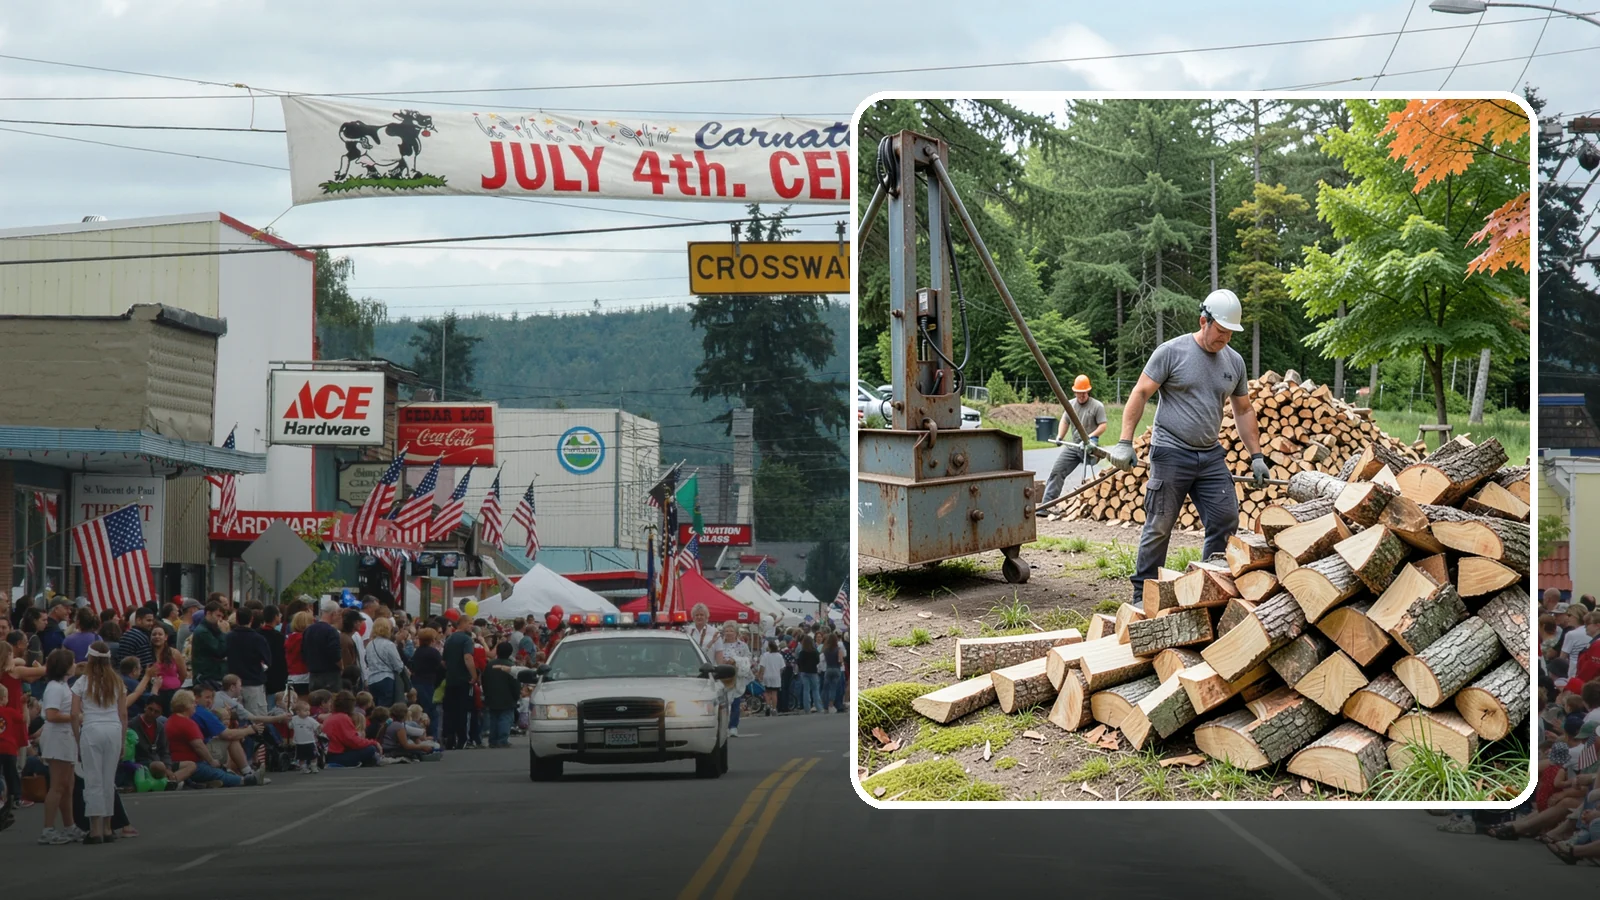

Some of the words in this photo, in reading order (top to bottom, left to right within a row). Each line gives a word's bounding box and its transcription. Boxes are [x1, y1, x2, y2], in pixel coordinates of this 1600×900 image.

[695, 121, 850, 150] Carnat
[481, 141, 604, 193] JULY
[632, 151, 746, 197] 4th.
[697, 254, 850, 280] CROSSWA
[283, 380, 373, 420] ACE
[405, 409, 452, 422] CEDAR
[283, 421, 370, 436] Hardware
[416, 428, 477, 447] Coca-Cola
[353, 467, 385, 479] Simpl
[83, 485, 94, 494] St.
[96, 486, 124, 494] Vincent
[126, 486, 135, 495] de
[137, 487, 154, 495] Paul
[699, 535, 730, 543] GLASS
